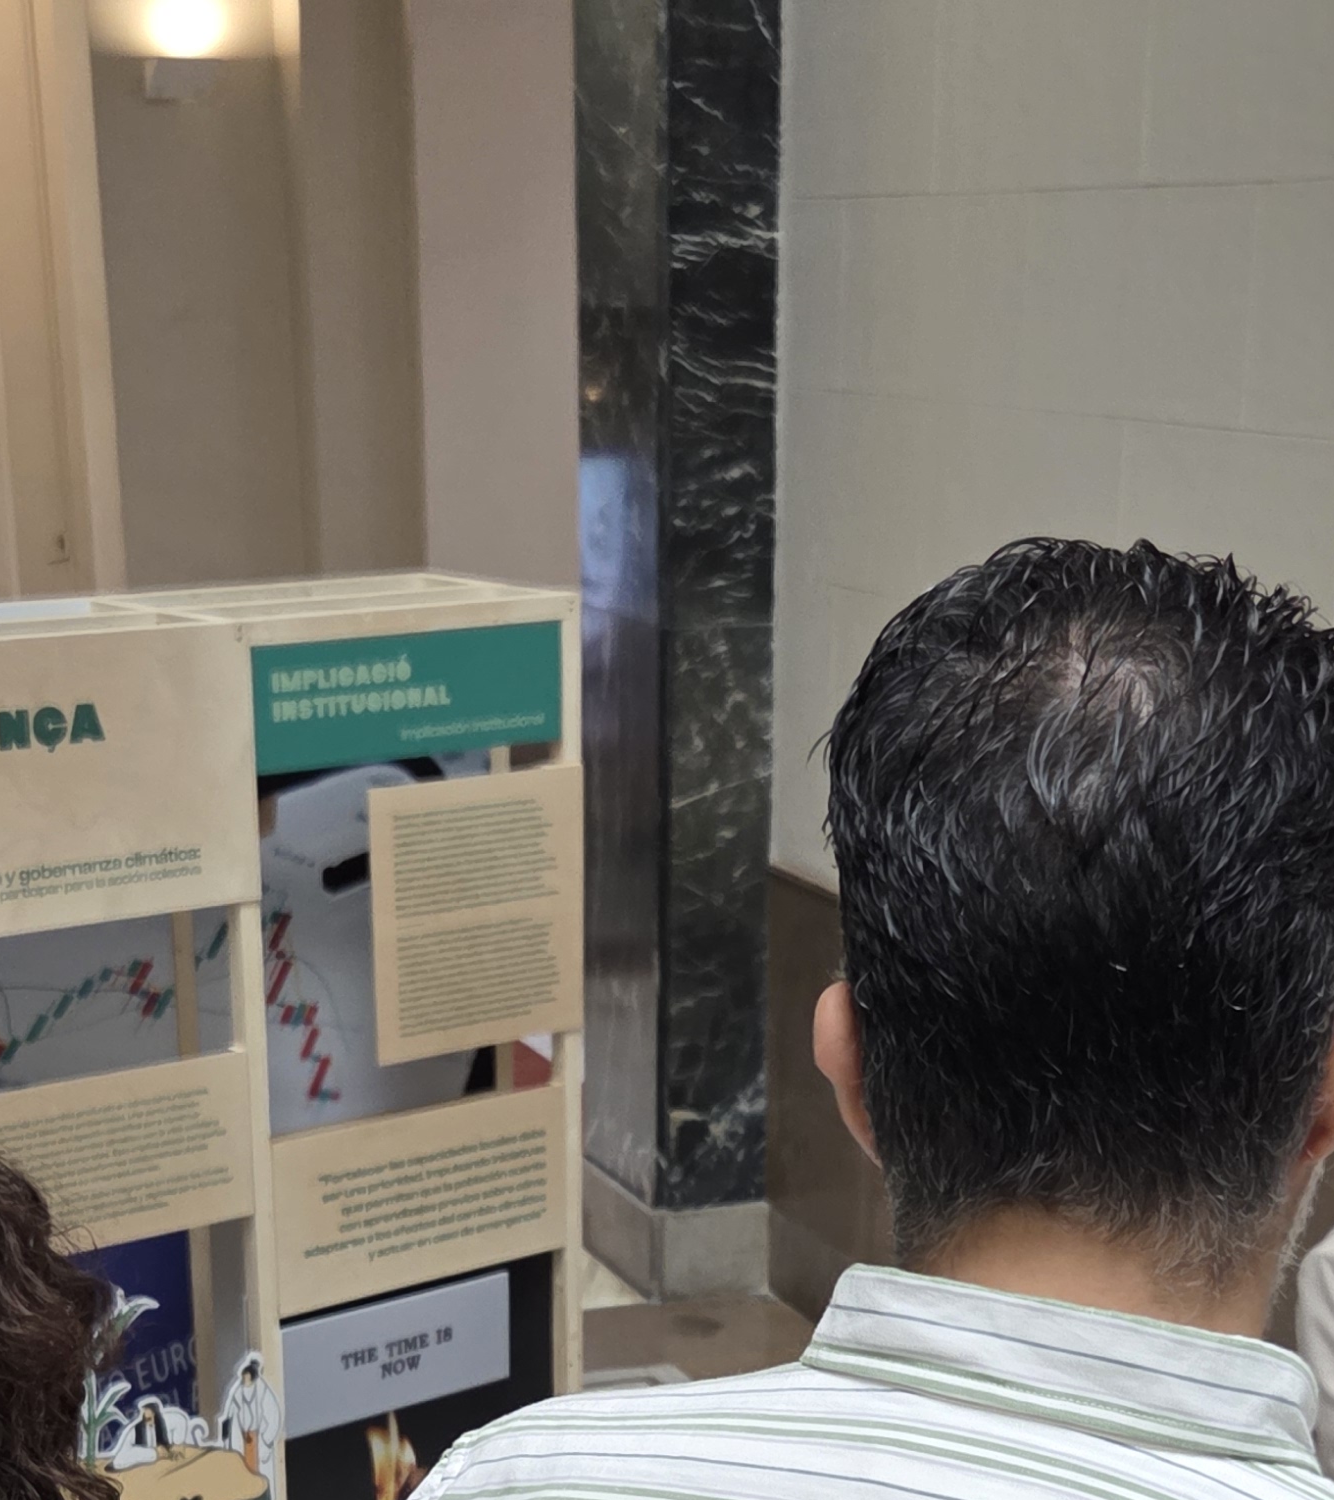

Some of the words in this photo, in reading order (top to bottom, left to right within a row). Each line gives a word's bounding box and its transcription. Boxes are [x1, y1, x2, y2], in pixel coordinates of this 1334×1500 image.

[273, 685, 451, 722] INSTITUCIONAL
[5, 867, 17, 887] y
[19, 856, 121, 885] gobernanza
[124, 847, 201, 869] climática:
[341, 1347, 378, 1370] THE
[386, 1333, 429, 1357] TIME
[436, 1326, 452, 1345] IS
[381, 1354, 421, 1379] NOW
